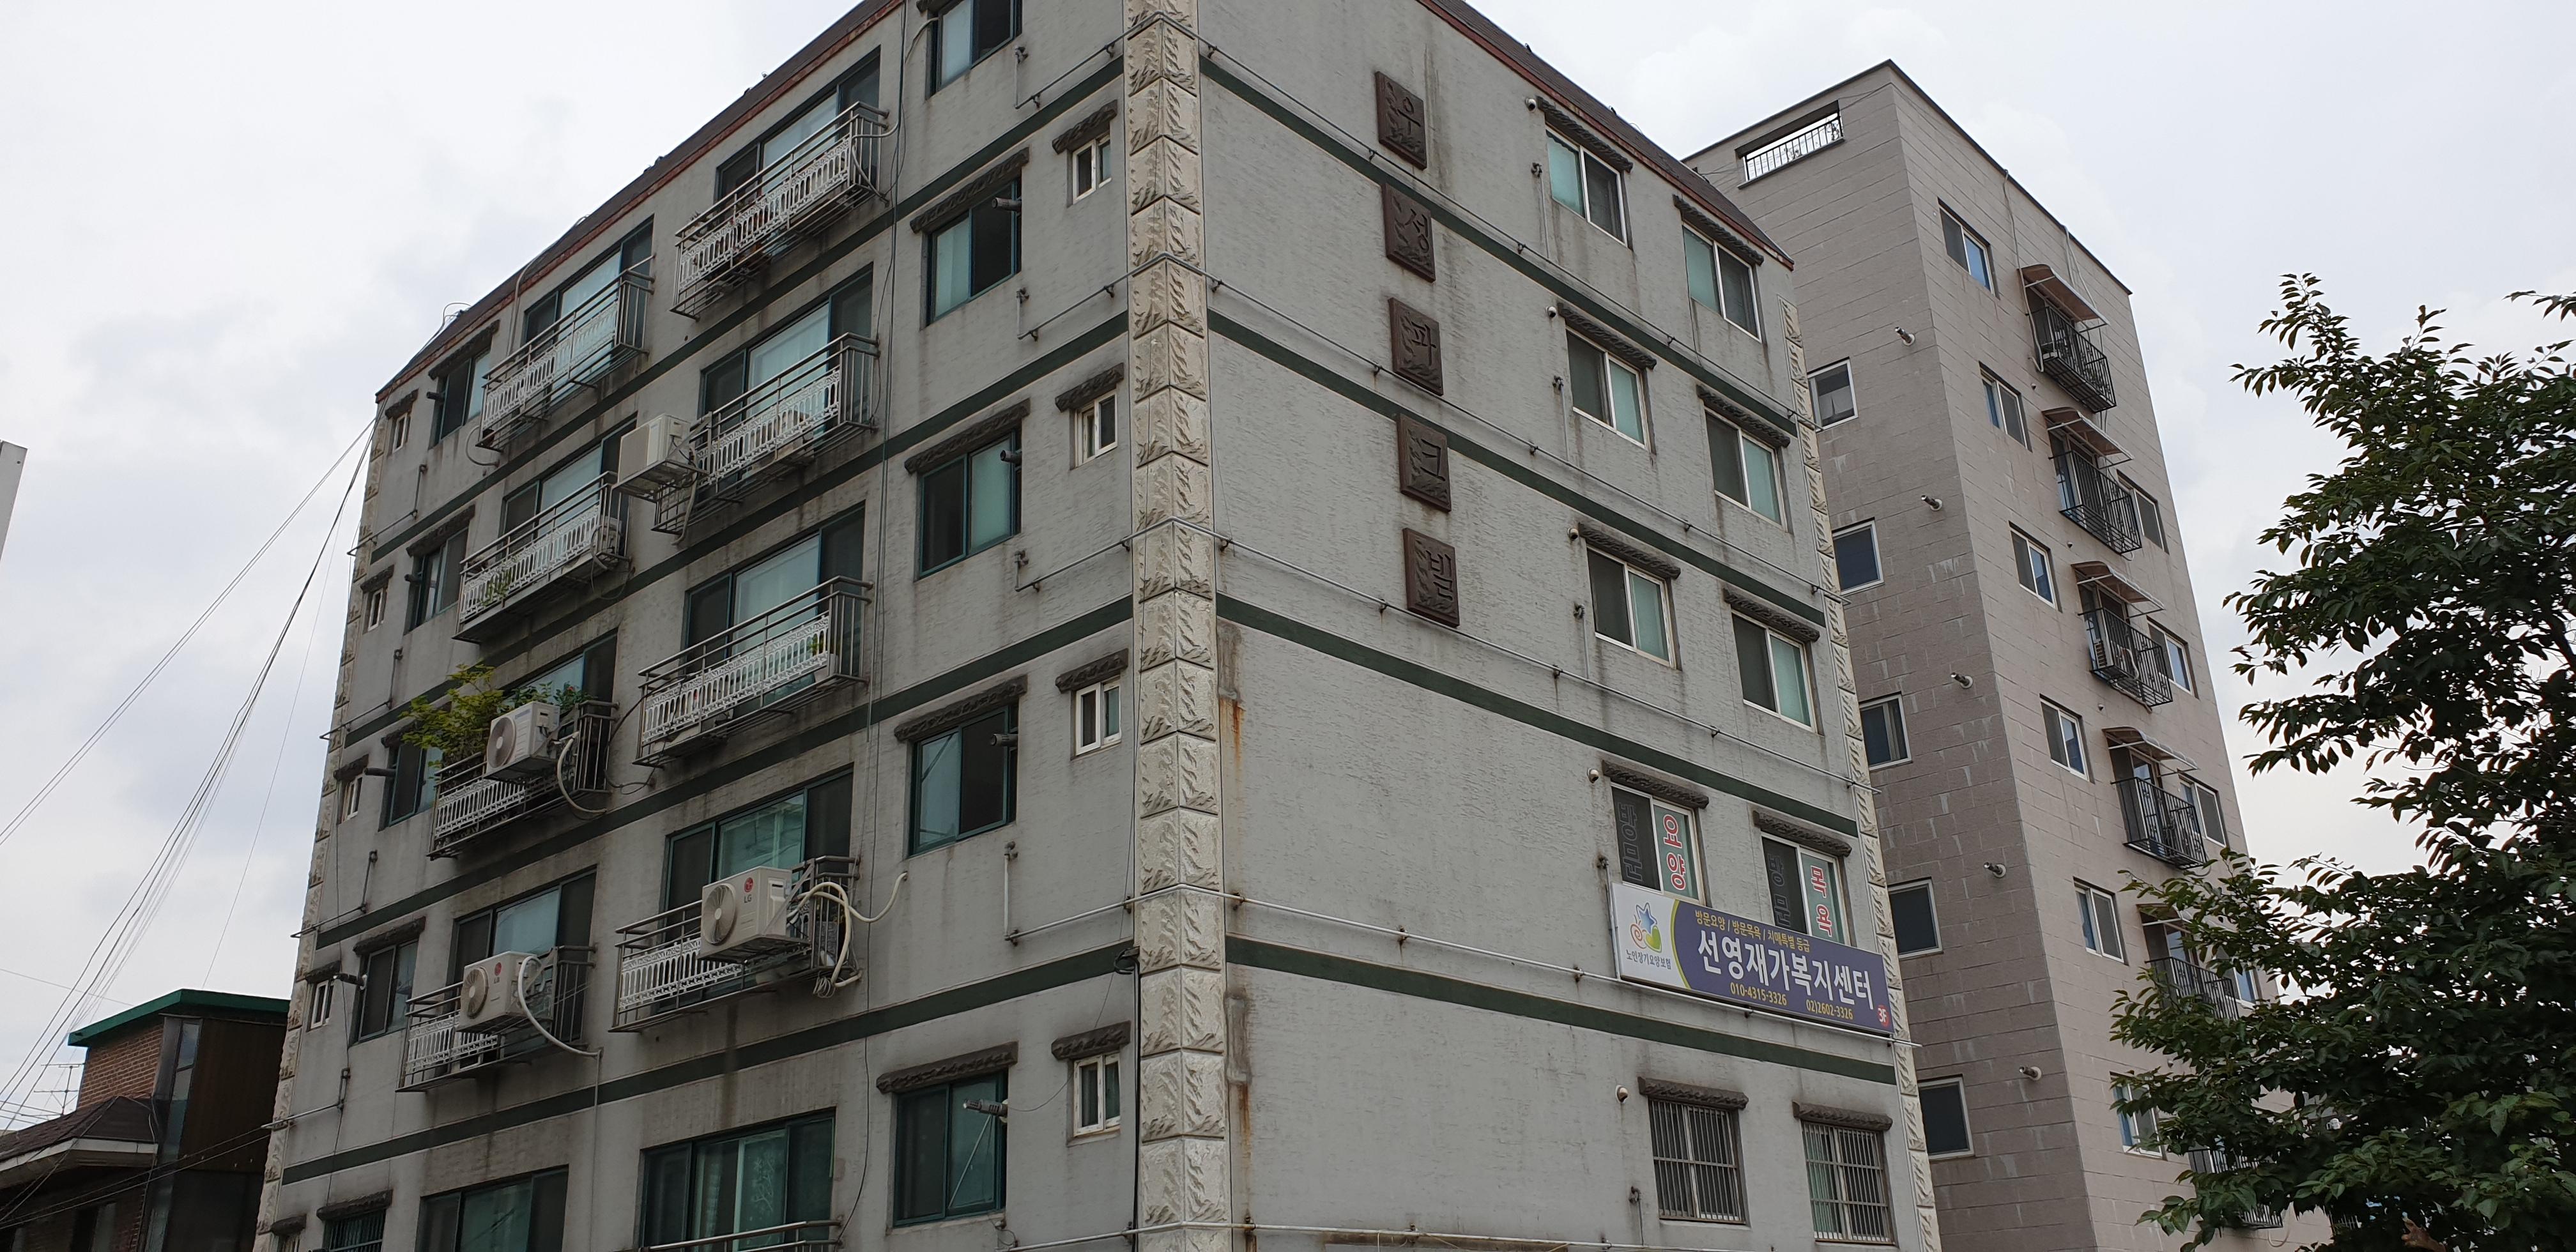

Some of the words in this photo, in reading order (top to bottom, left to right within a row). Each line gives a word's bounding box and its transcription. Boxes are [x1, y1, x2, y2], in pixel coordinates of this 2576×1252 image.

[1618, 802, 1643, 882] 방문
[1663, 814, 1686, 890] 요양
[744, 894, 752, 903] LG
[1767, 853, 1791, 928] 방문
[1810, 865, 1832, 938] 목욕
[1694, 910, 1726, 931] 방문요양
[1732, 919, 1761, 941] 방문목욕
[1767, 930, 1795, 950] 치매특별
[1796, 937, 1810, 952] 등급
[1625, 949, 1671, 970] 노인장기요양보험
[1698, 929, 1874, 1011] 선영재가복지센터
[1729, 982, 1788, 1007] 010-4315-3326
[1805, 998, 1853, 1020] 02)2602-3326
[1878, 1007, 1887, 1023] 3F
